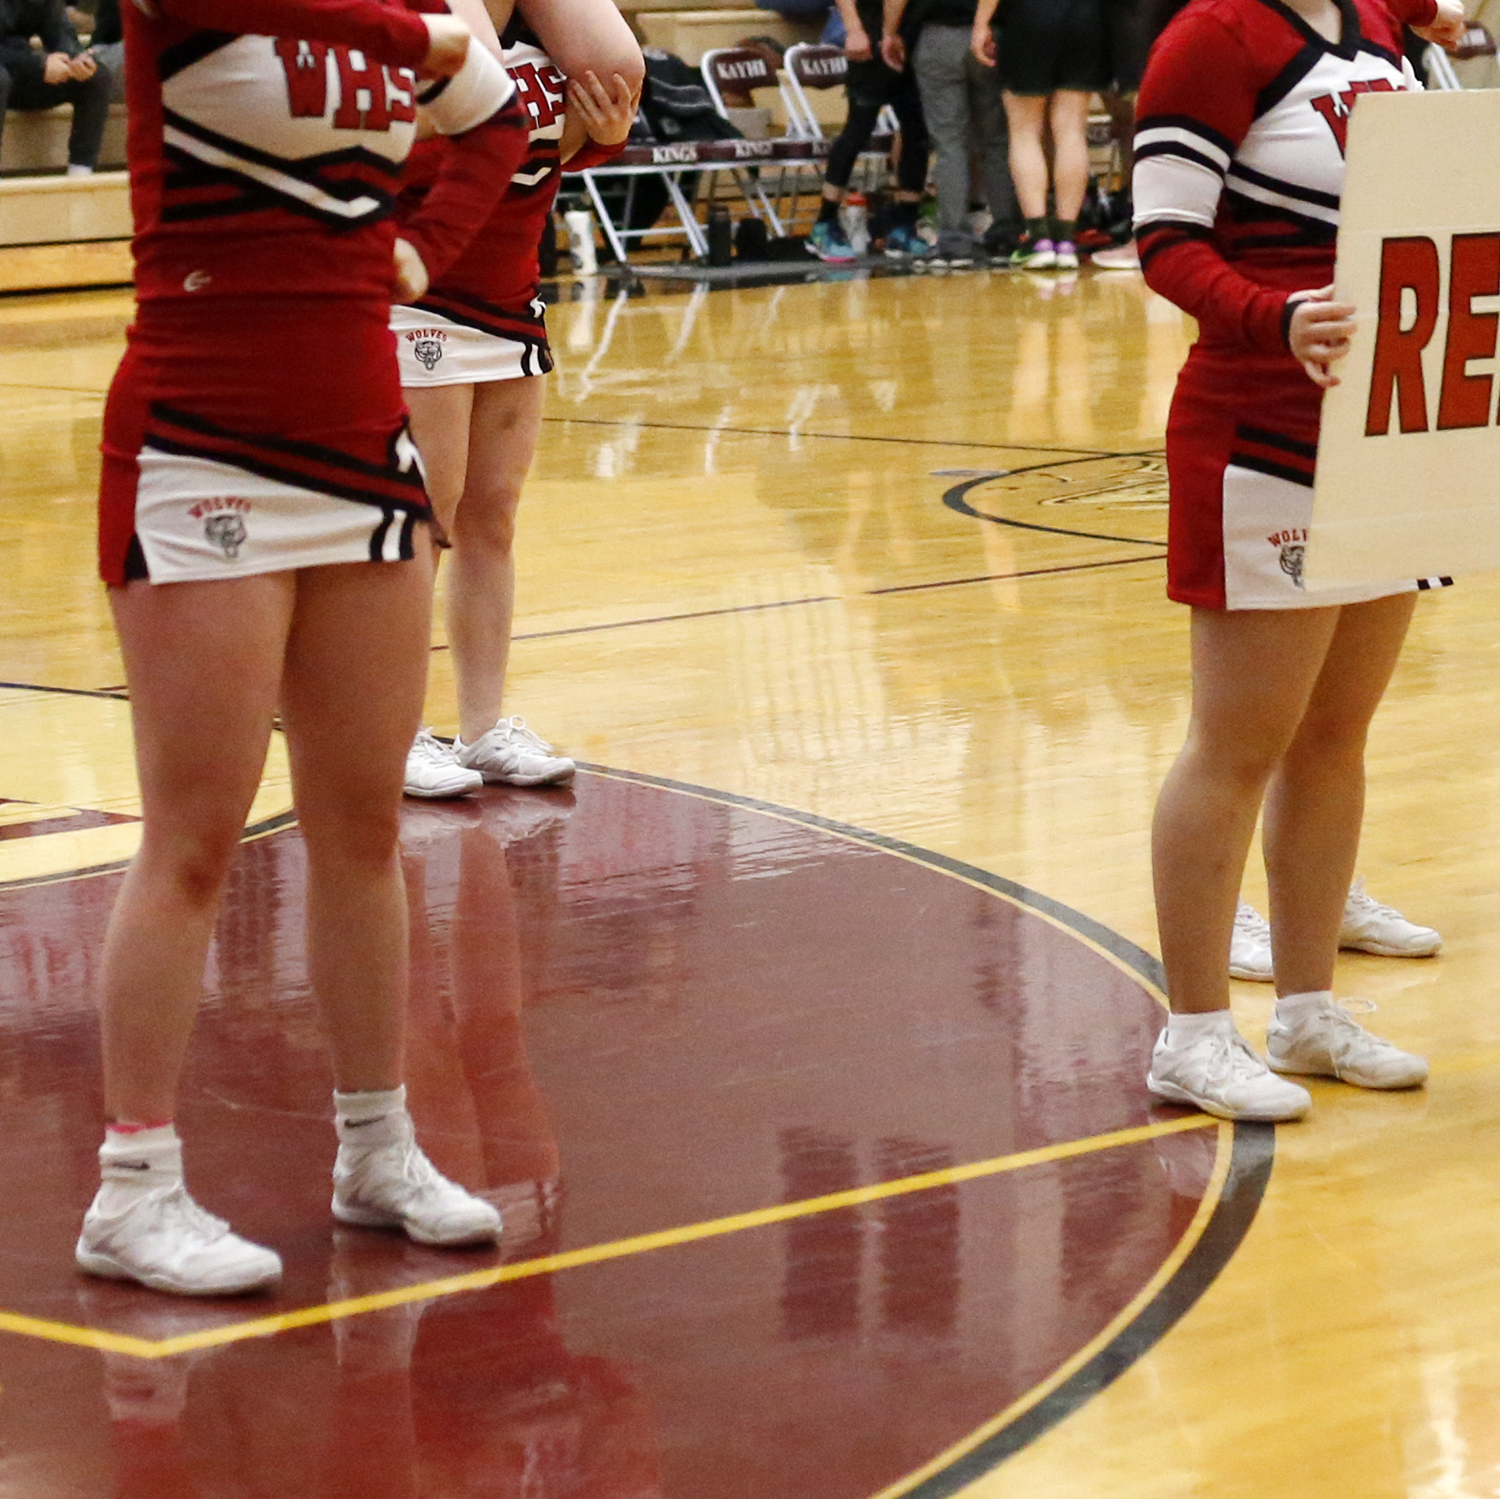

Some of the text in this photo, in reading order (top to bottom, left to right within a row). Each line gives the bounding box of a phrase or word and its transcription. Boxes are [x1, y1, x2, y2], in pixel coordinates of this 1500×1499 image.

[716, 59, 767, 79] KAYHI
[800, 56, 848, 75] KAYHI
[273, 38, 417, 130] WHS
[652, 145, 698, 163] KINGS
[406, 328, 449, 345] WOLVES
[188, 496, 252, 521] WOLVES
